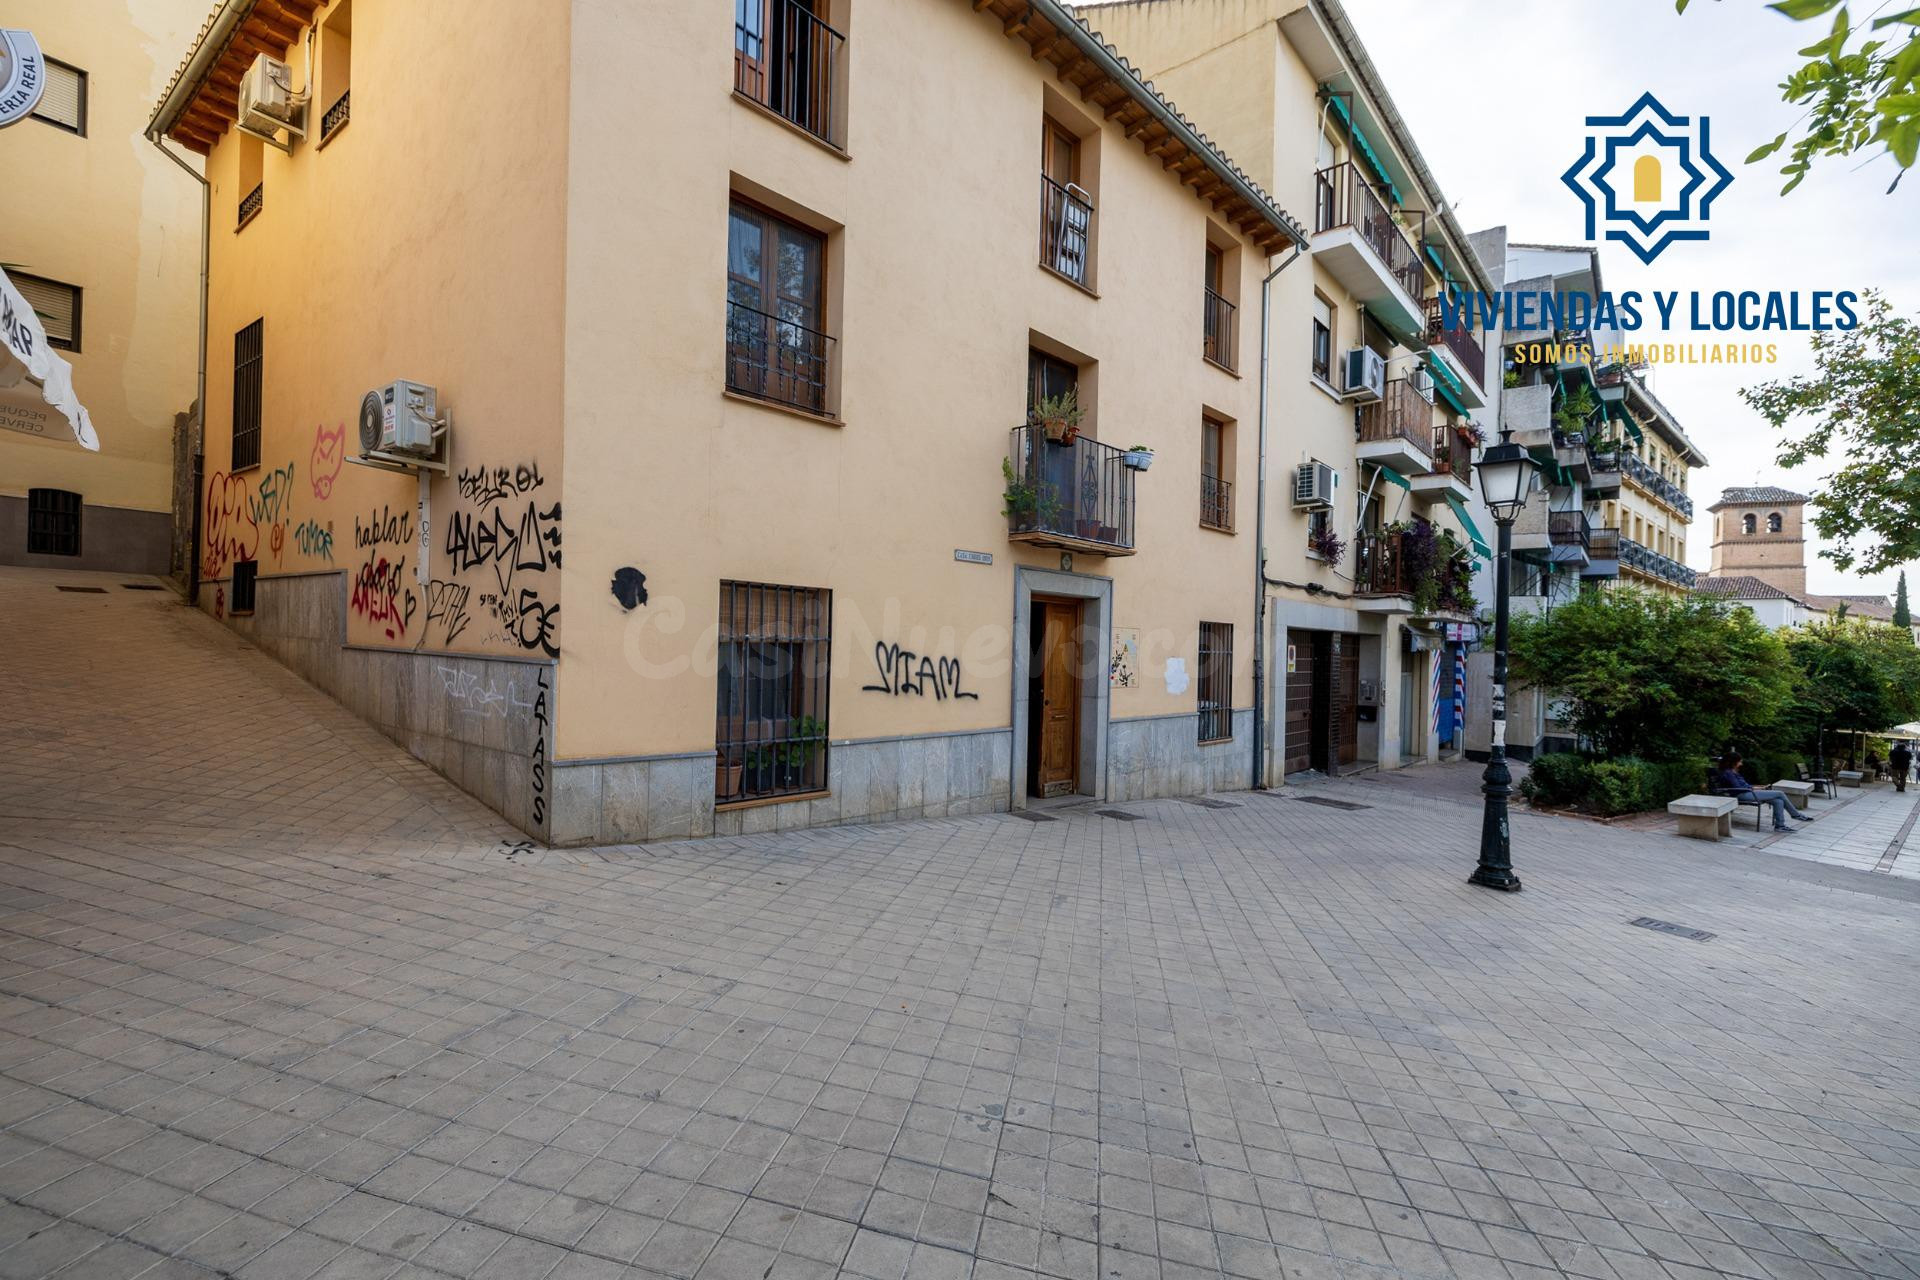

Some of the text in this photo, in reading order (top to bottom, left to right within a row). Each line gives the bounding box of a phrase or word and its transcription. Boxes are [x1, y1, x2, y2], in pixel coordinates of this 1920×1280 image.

[21, 55, 37, 90] REAL
[355, 504, 413, 549] hablar
[862, 641, 978, 701] MIAM
